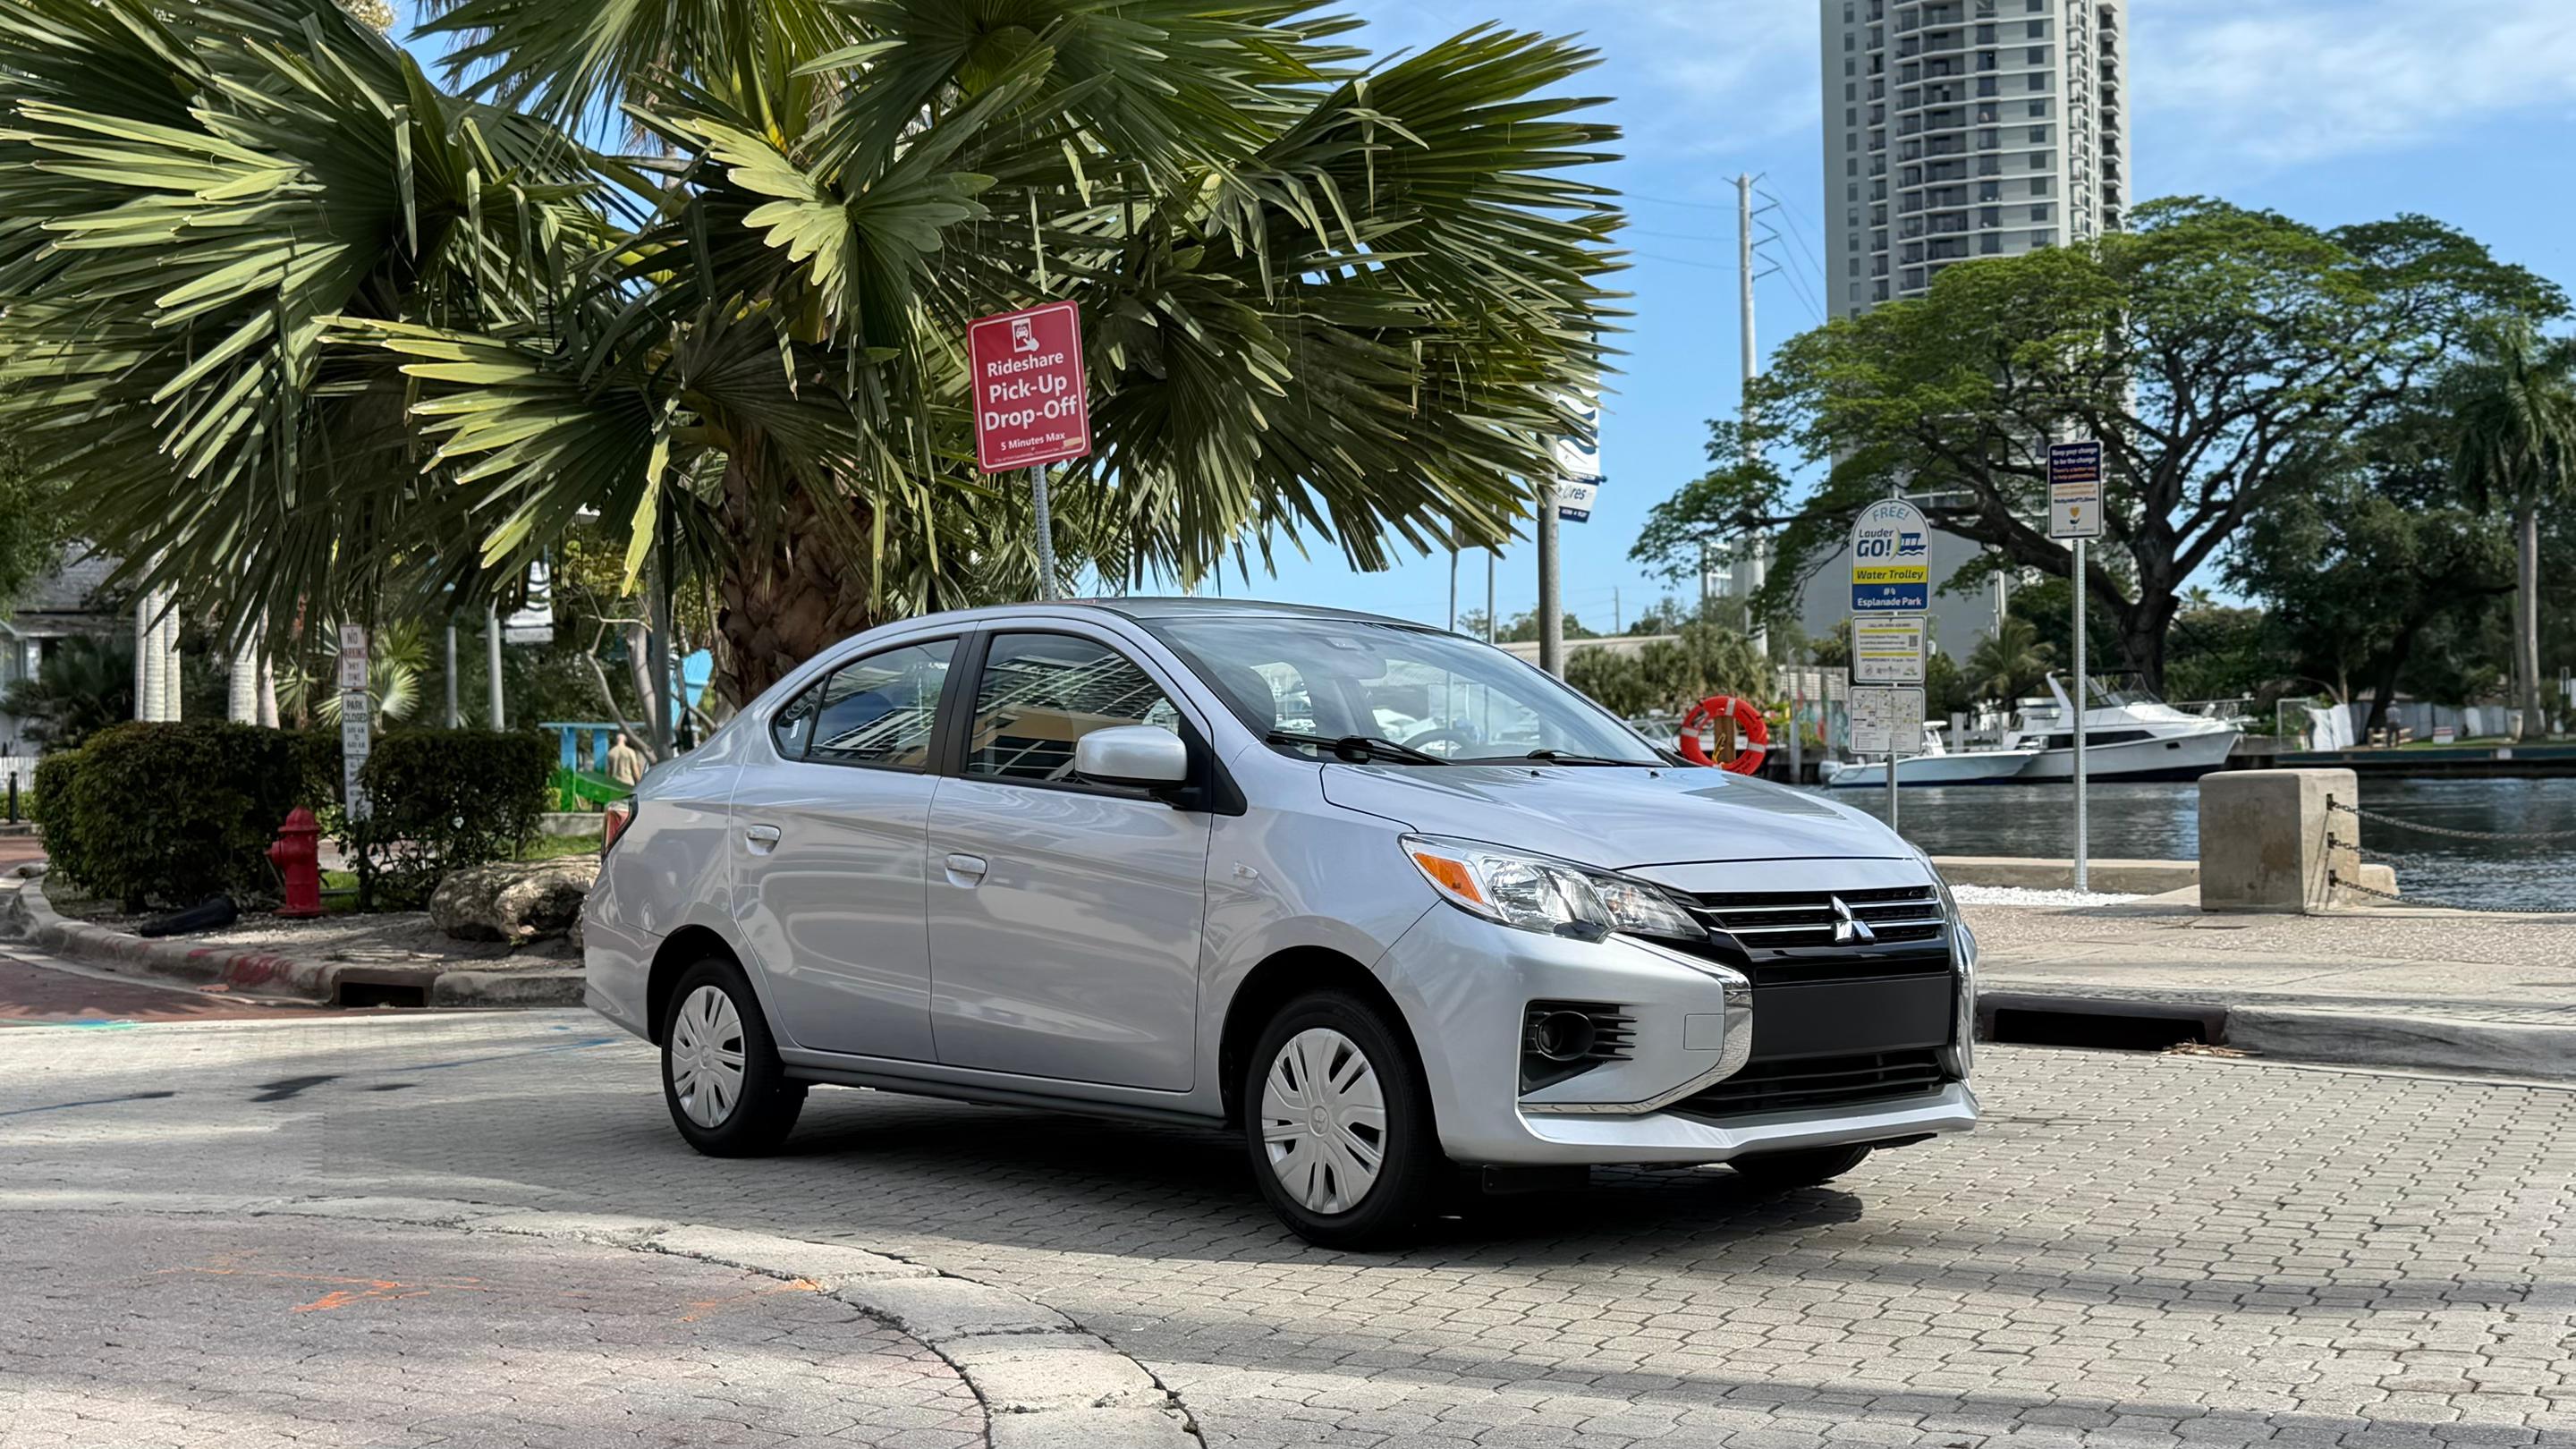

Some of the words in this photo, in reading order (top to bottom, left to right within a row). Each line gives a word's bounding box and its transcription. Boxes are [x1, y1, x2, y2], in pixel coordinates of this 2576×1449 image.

[987, 352, 1064, 377] Rideshare
[989, 374, 1067, 402] Pick-Up
[985, 395, 1077, 431] Drop-Off
[1001, 441, 1007, 451] 5
[1009, 436, 1045, 449] Minutes
[1046, 431, 1065, 443] Max
[1872, 506, 1911, 521] FREE!
[1860, 529, 1894, 538] Lauder
[1857, 538, 1892, 557] GO!
[1857, 570, 1886, 580] Water
[1889, 570, 1923, 580] Trolley
[1857, 597, 1901, 607] Esplanade
[1902, 597, 1922, 606] Park
[347, 631, 358, 644] NO
[346, 699, 364, 710] PARK
[344, 713, 367, 723] CLOSED
